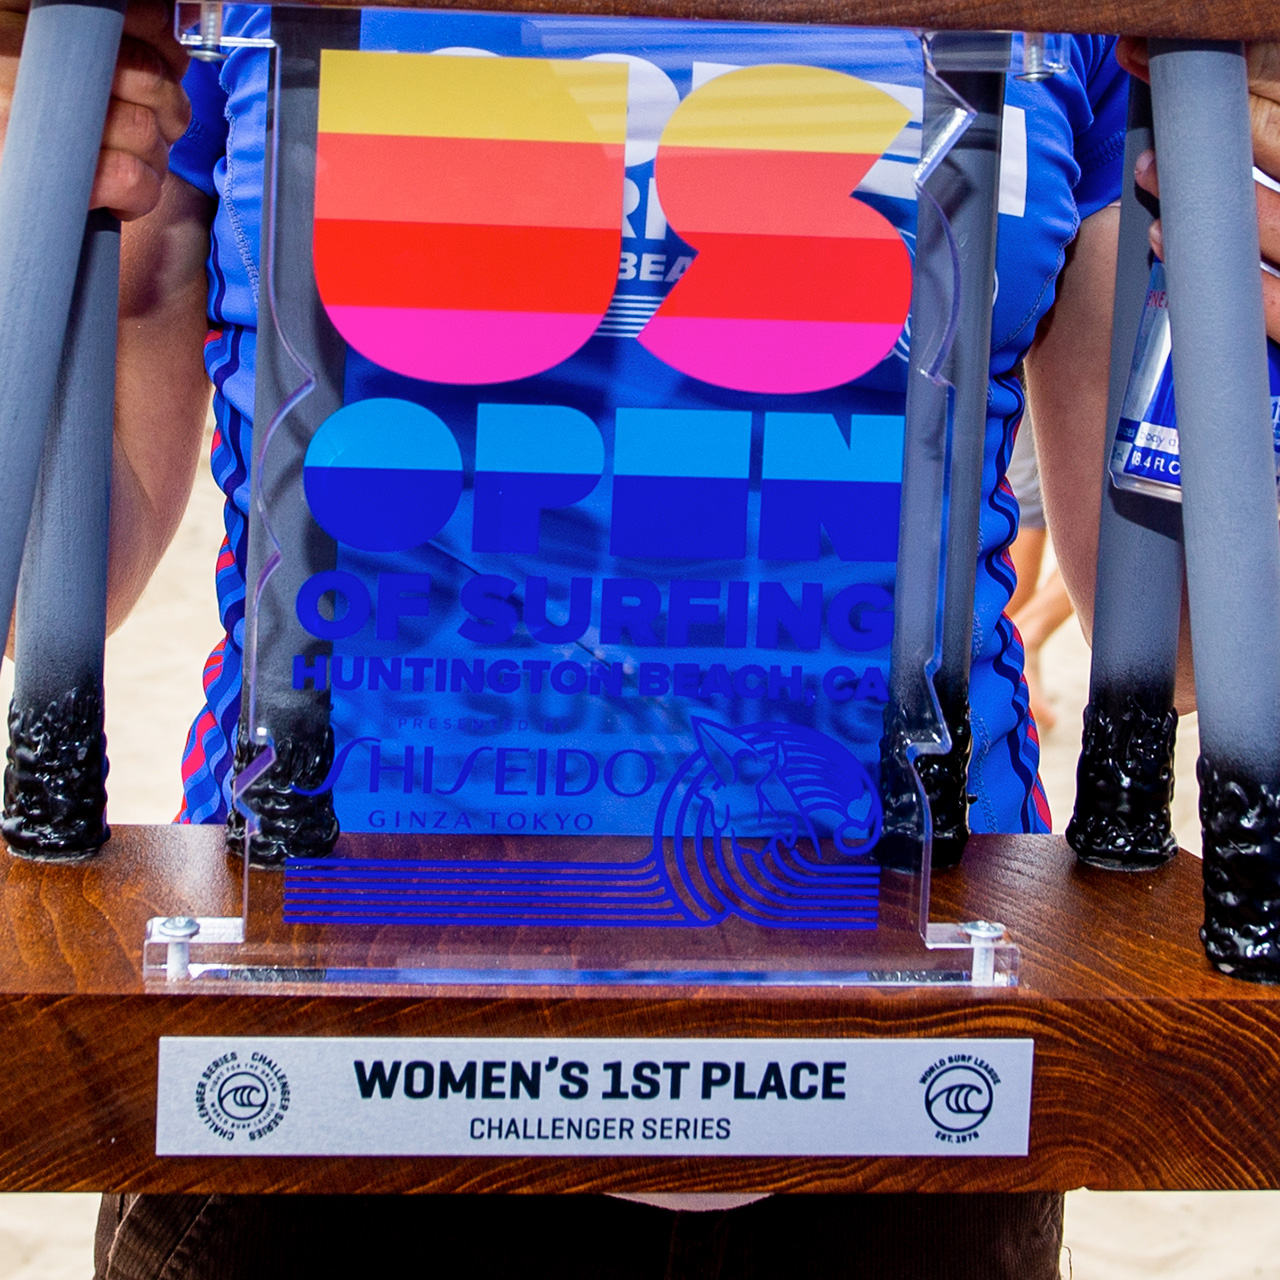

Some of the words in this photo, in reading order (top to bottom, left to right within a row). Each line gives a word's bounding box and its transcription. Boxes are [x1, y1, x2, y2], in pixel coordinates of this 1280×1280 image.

[312, 47, 915, 394] US
[303, 397, 906, 562] OPEN
[1153, 456, 1165, 472] FL
[295, 570, 433, 642] OF
[457, 573, 897, 653] SURFING
[291, 654, 624, 697] HUNTINGTON
[637, 661, 817, 707] BEACH,
[822, 666, 891, 703] CA
[289, 736, 657, 798] SHISEIDO
[367, 809, 473, 830] GINZA
[486, 811, 595, 832] TOKYO
[353, 1055, 589, 1100] WOMEN'S
[601, 1061, 690, 1100] 1ST
[701, 1061, 847, 1100] PLACE
[469, 1117, 635, 1140] CHALLENGER
[642, 1118, 732, 1140] SERIES
